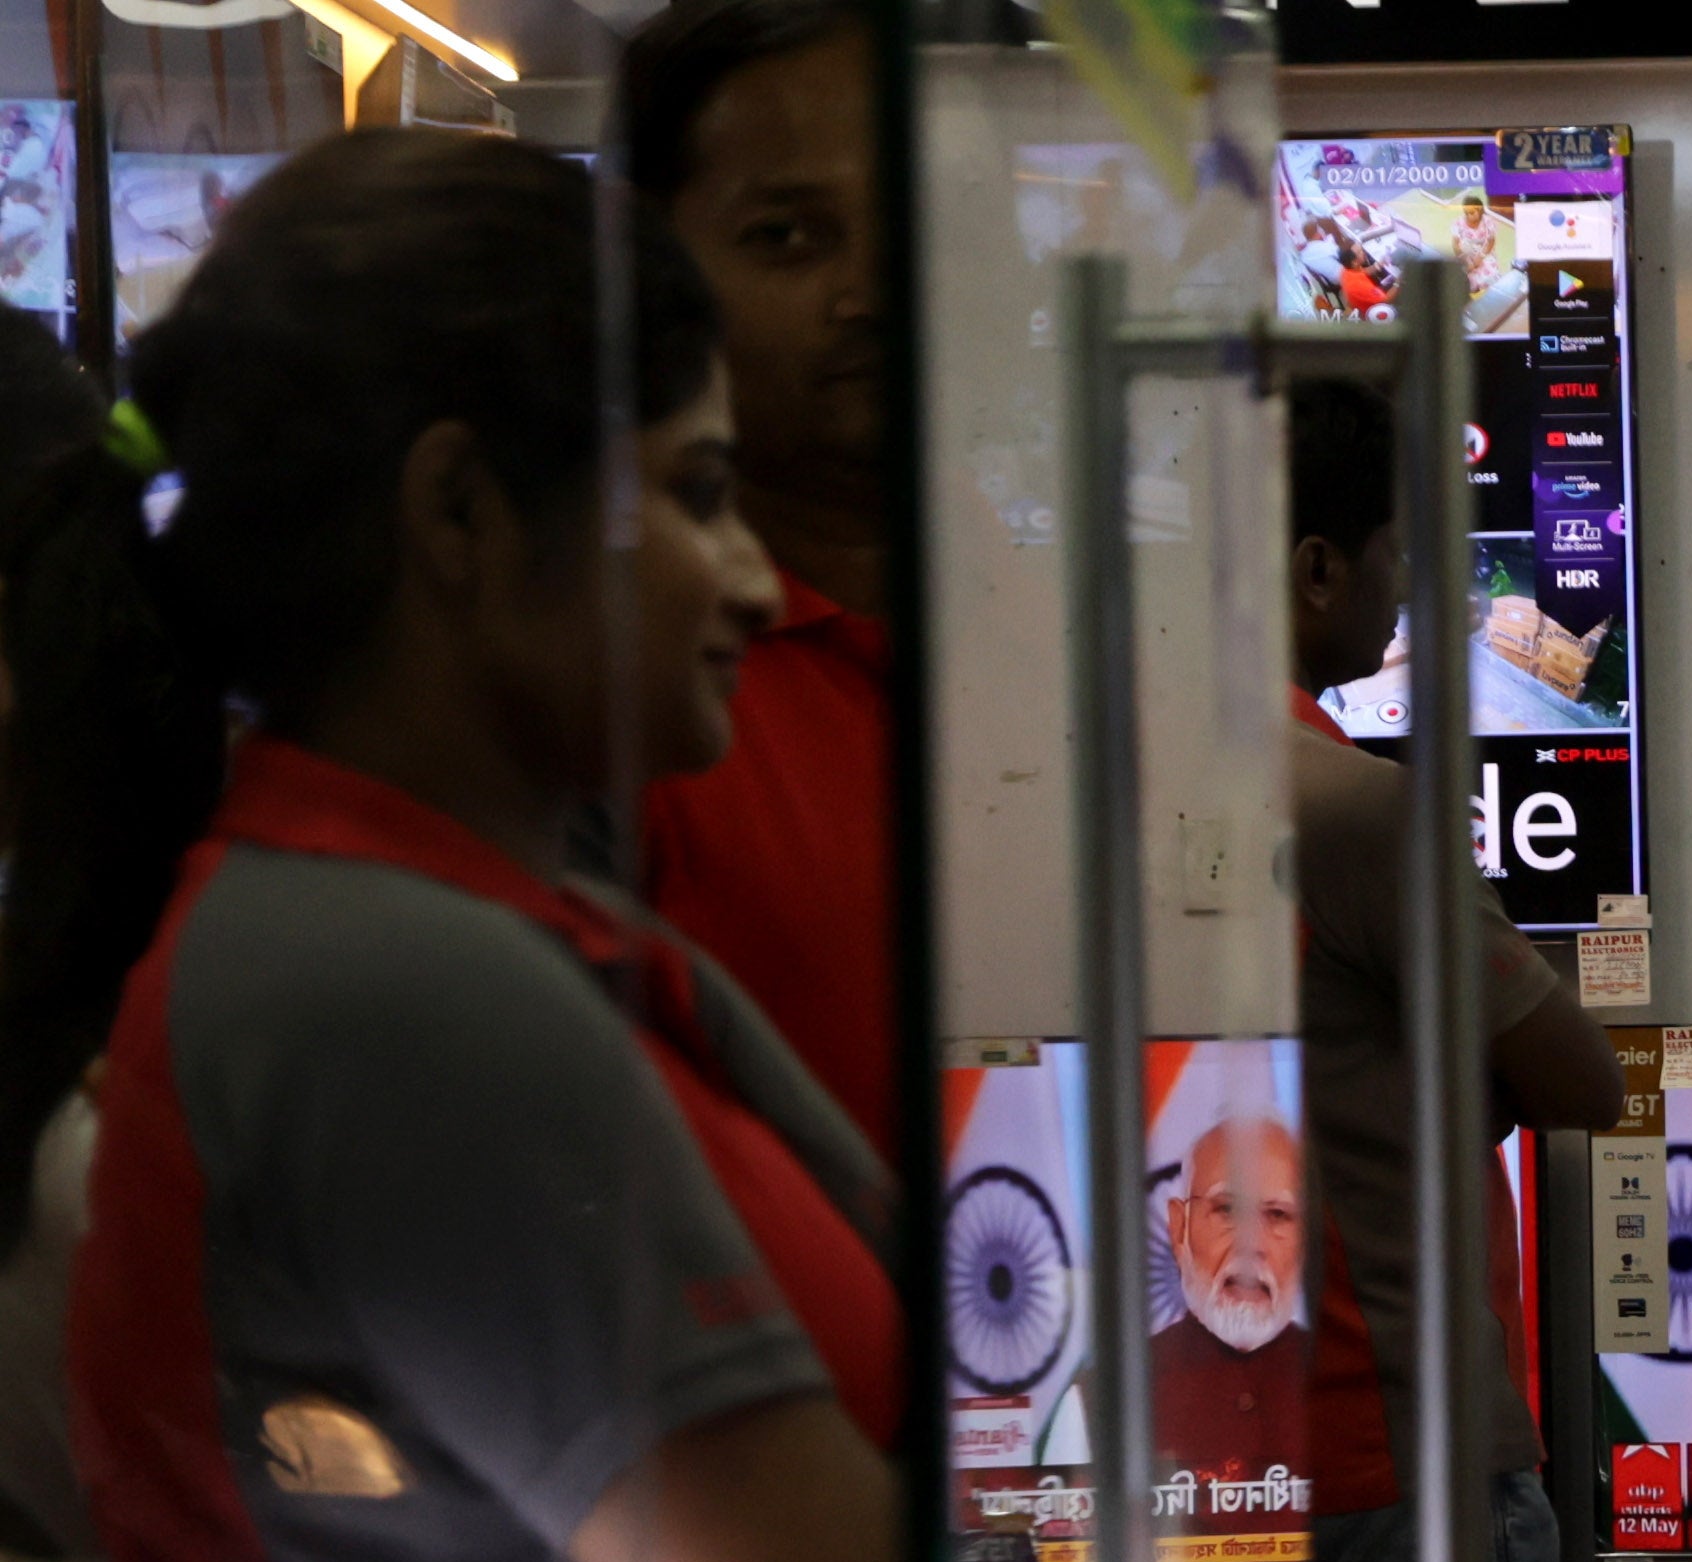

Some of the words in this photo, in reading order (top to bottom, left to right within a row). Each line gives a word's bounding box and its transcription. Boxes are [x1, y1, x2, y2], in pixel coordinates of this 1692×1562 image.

[1513, 132, 1535, 170] 2
[1537, 134, 1592, 154] YEAR
[1326, 164, 1449, 186] 02/01/2000
[1554, 300, 1576, 309] Google
[1560, 335, 1605, 345] Chromecast
[1550, 383, 1598, 398] NETFLIX
[1566, 432, 1604, 446] YouTube
[1467, 471, 1499, 484] Loss
[1577, 482, 1600, 490] video
[1552, 542, 1603, 551] Multi-Screen
[1556, 570, 1600, 588] HDR
[1557, 749, 1581, 762] CP
[1585, 748, 1629, 761] PLUS
[1581, 934, 1644, 946] RAIPUR
[1581, 946, 1645, 955] ELECTRONICS
[1616, 1045, 1656, 1066] aier
[1617, 1152, 1644, 1161] Google
[1617, 1518, 1637, 1534] 12
[1640, 1518, 1679, 1538] May
